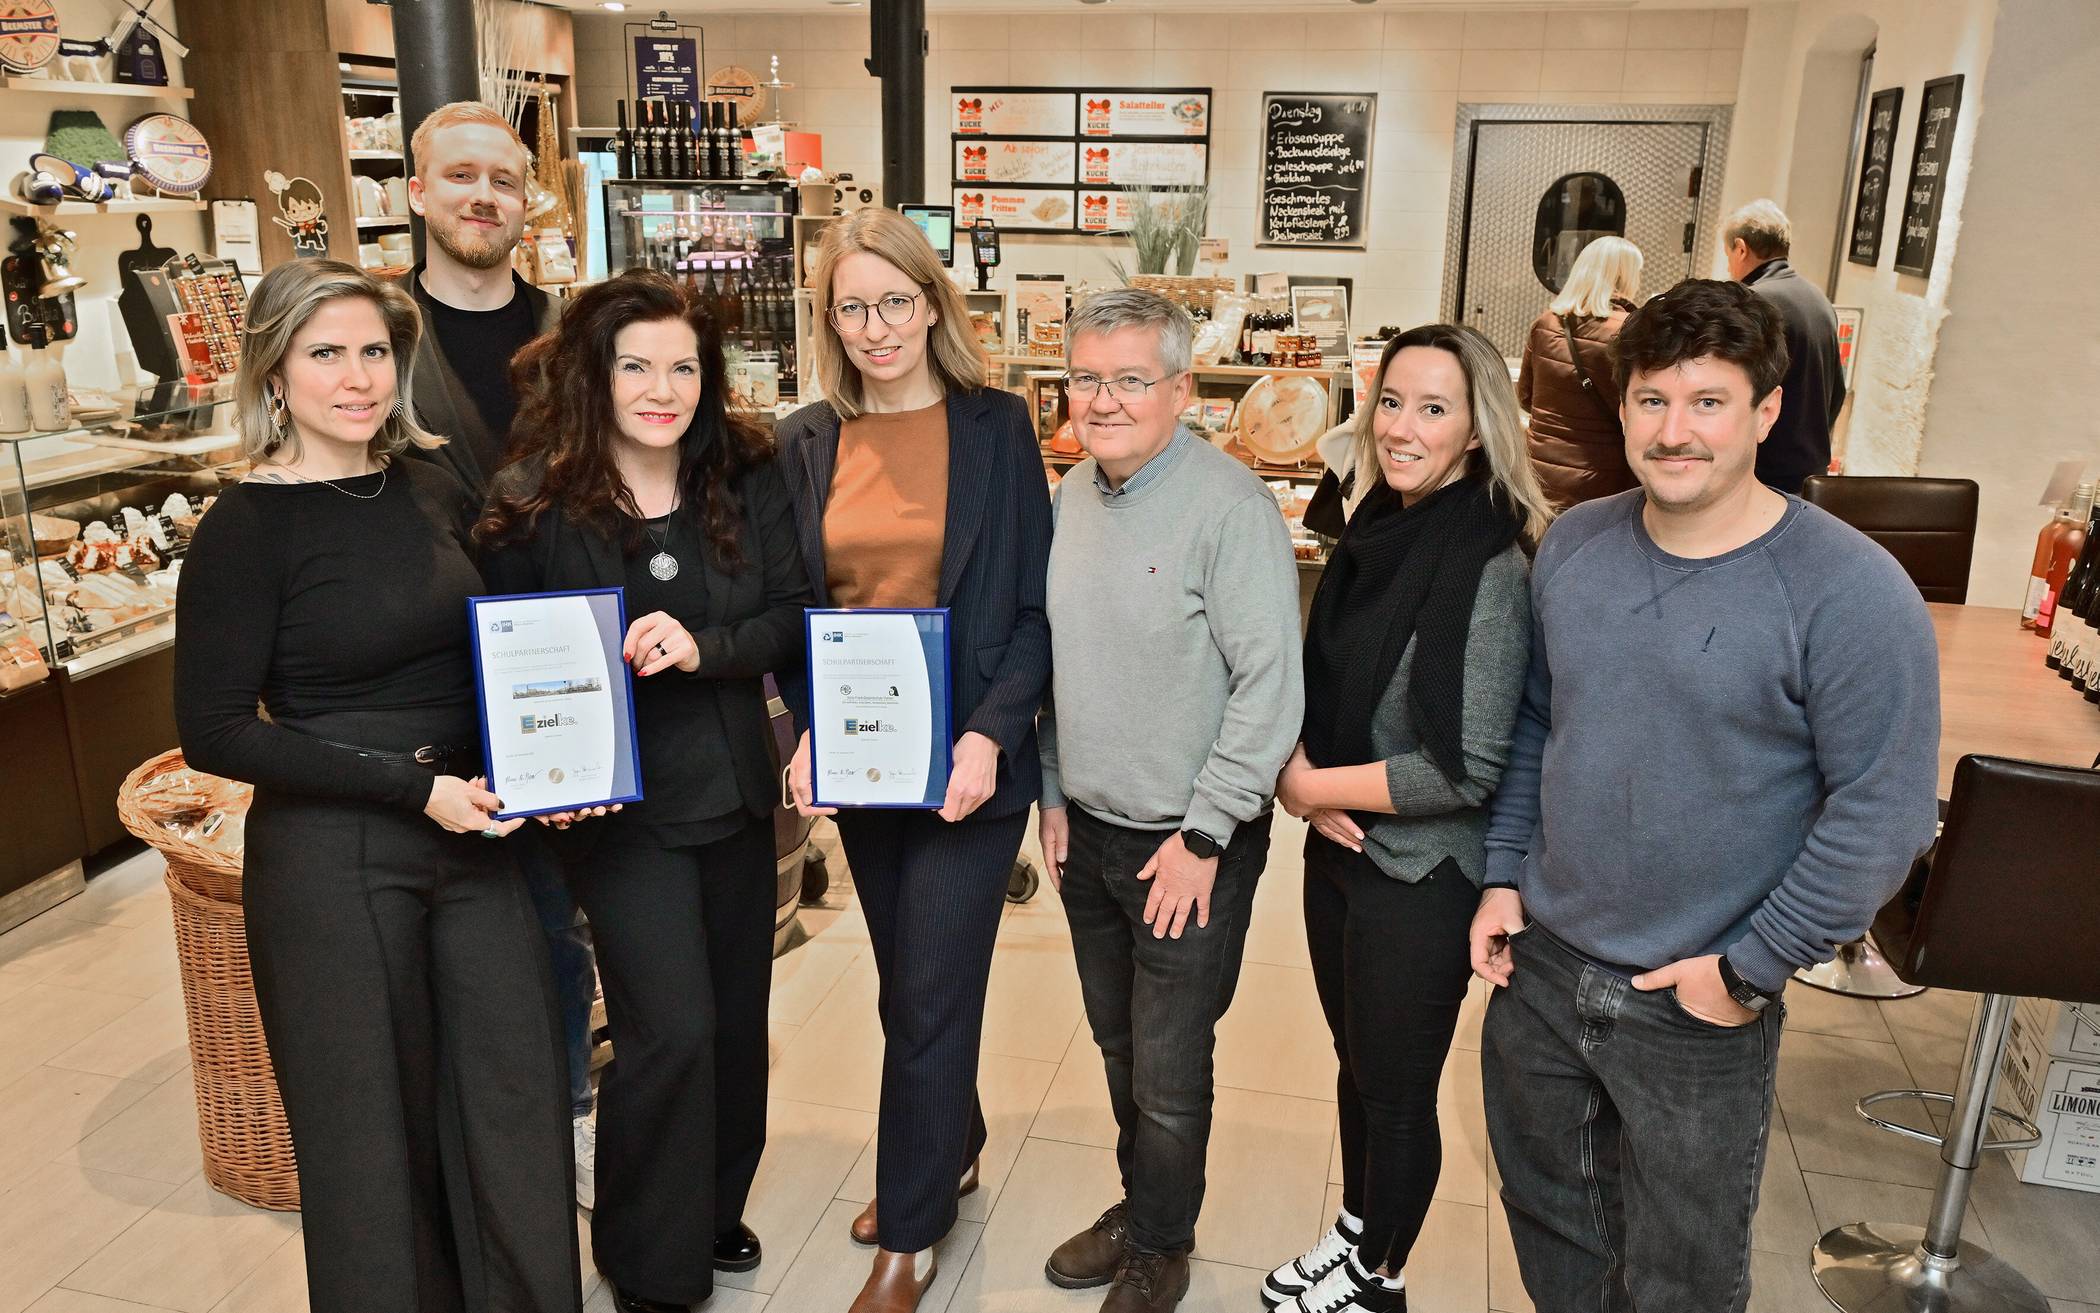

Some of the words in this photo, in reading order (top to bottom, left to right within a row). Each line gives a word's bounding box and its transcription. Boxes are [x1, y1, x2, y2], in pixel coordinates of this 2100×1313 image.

[1119, 100, 1166, 110] Salatteller
[1269, 102, 1322, 123] Dienstag
[1277, 131, 1345, 146] Erbsensuppe
[991, 195, 1025, 204] Pommes
[1270, 191, 1331, 204] Geschmortes
[492, 645, 570, 659] SCHULPARTNERSCHAFT
[823, 658, 896, 666] SCHULPARTNERSCHAFT
